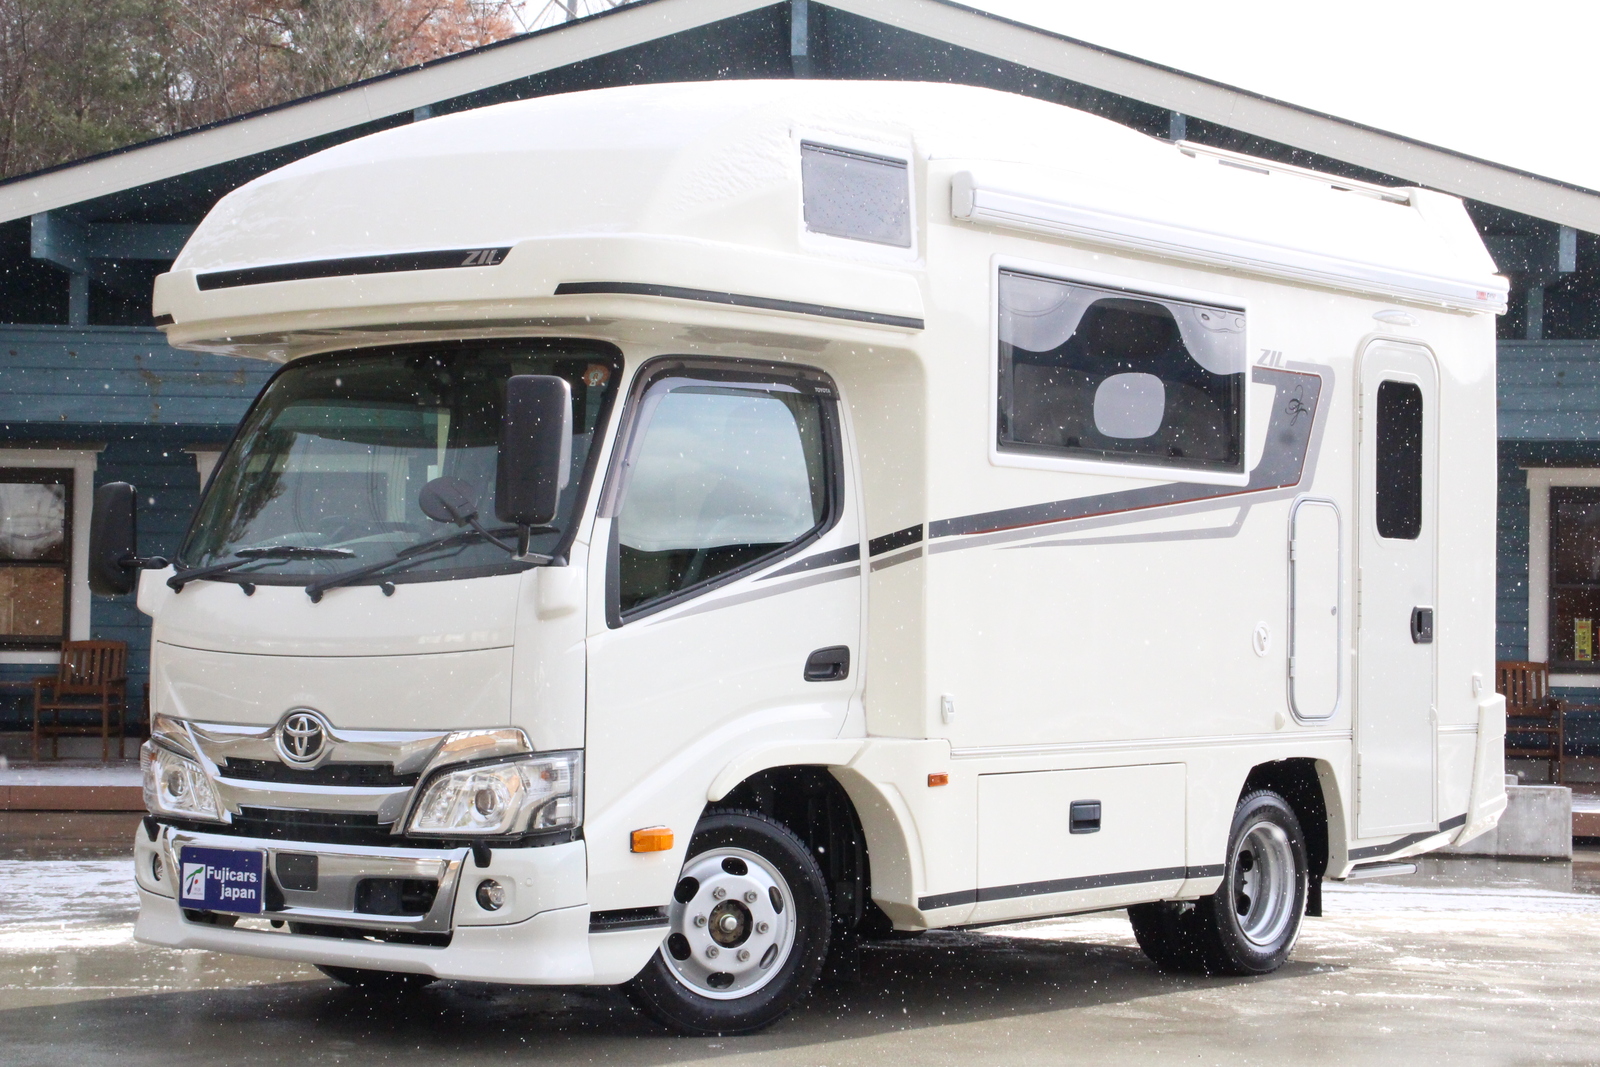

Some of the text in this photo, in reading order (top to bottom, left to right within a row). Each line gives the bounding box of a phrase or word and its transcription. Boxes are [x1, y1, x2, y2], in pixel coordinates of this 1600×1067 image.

[461, 249, 500, 266] ZIL
[1256, 348, 1285, 369] ZIL
[206, 866, 257, 884] Fujicars
[219, 883, 256, 901] japan
